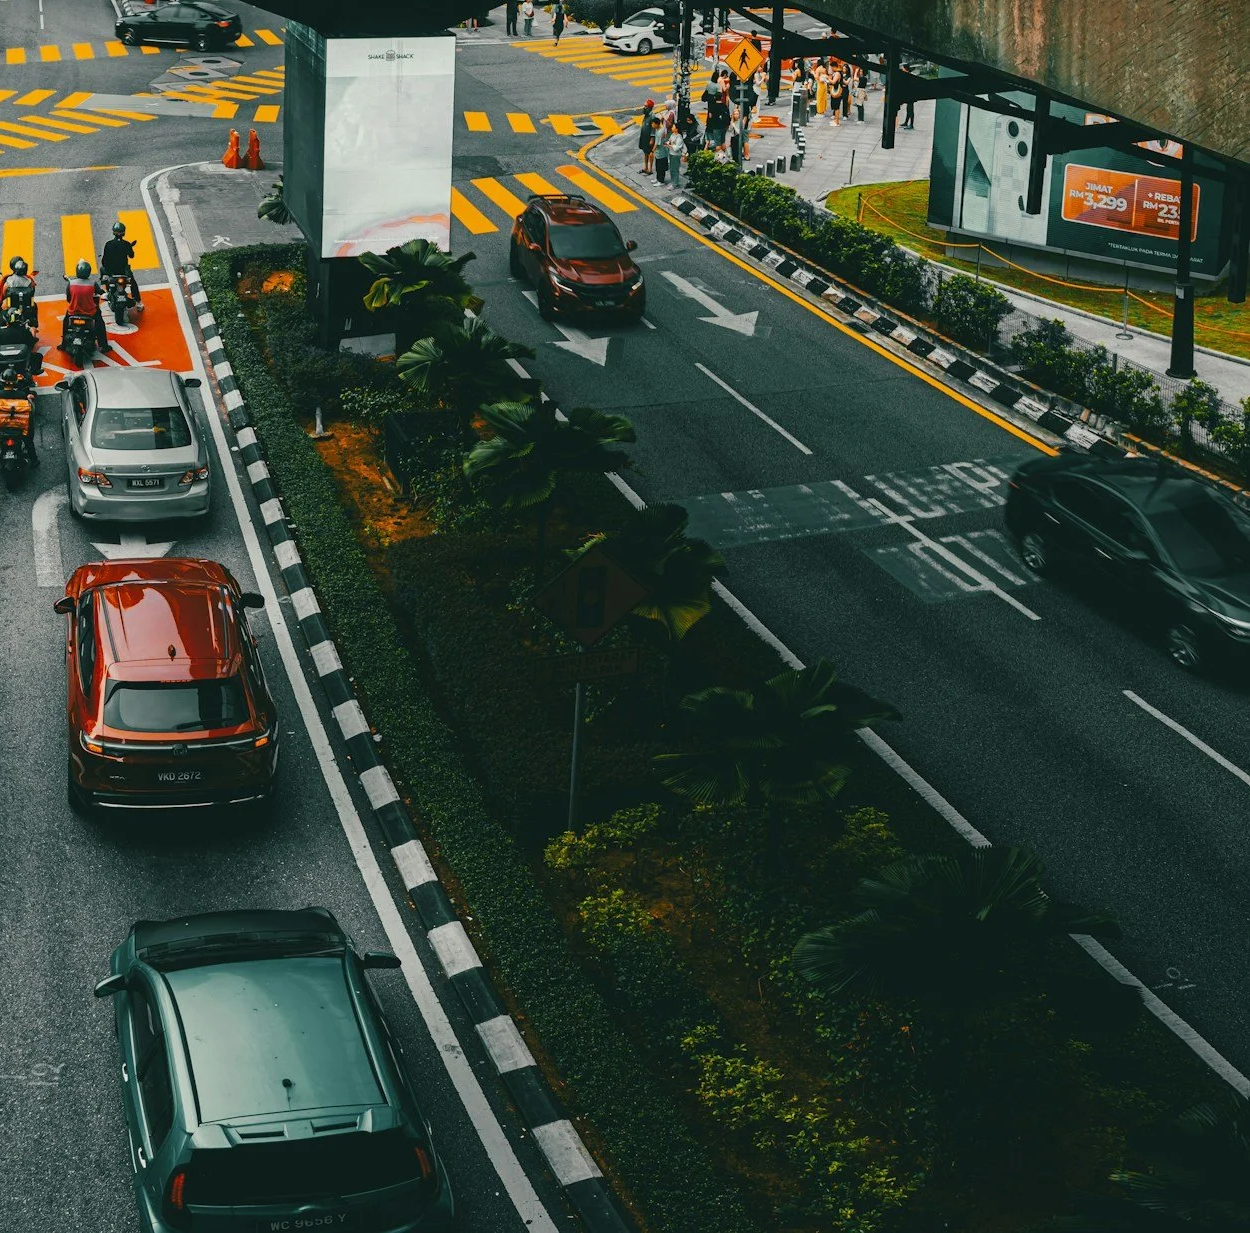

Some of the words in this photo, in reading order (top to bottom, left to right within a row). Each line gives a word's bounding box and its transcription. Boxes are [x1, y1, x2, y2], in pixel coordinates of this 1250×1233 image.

[1086, 182, 1113, 194] JIMAT
[1070, 189, 1084, 199] RM
[1084, 191, 1127, 212] 3,299
[1154, 192, 1181, 204] REBA
[1143, 201, 1158, 210] RM
[1157, 204, 1181, 219] 23
[1154, 250, 1171, 258] TERMA
[157, 772, 176, 781] VKD
[177, 771, 202, 780] 2672
[270, 1221, 290, 1231] WC
[338, 1213, 347, 1222] Y
